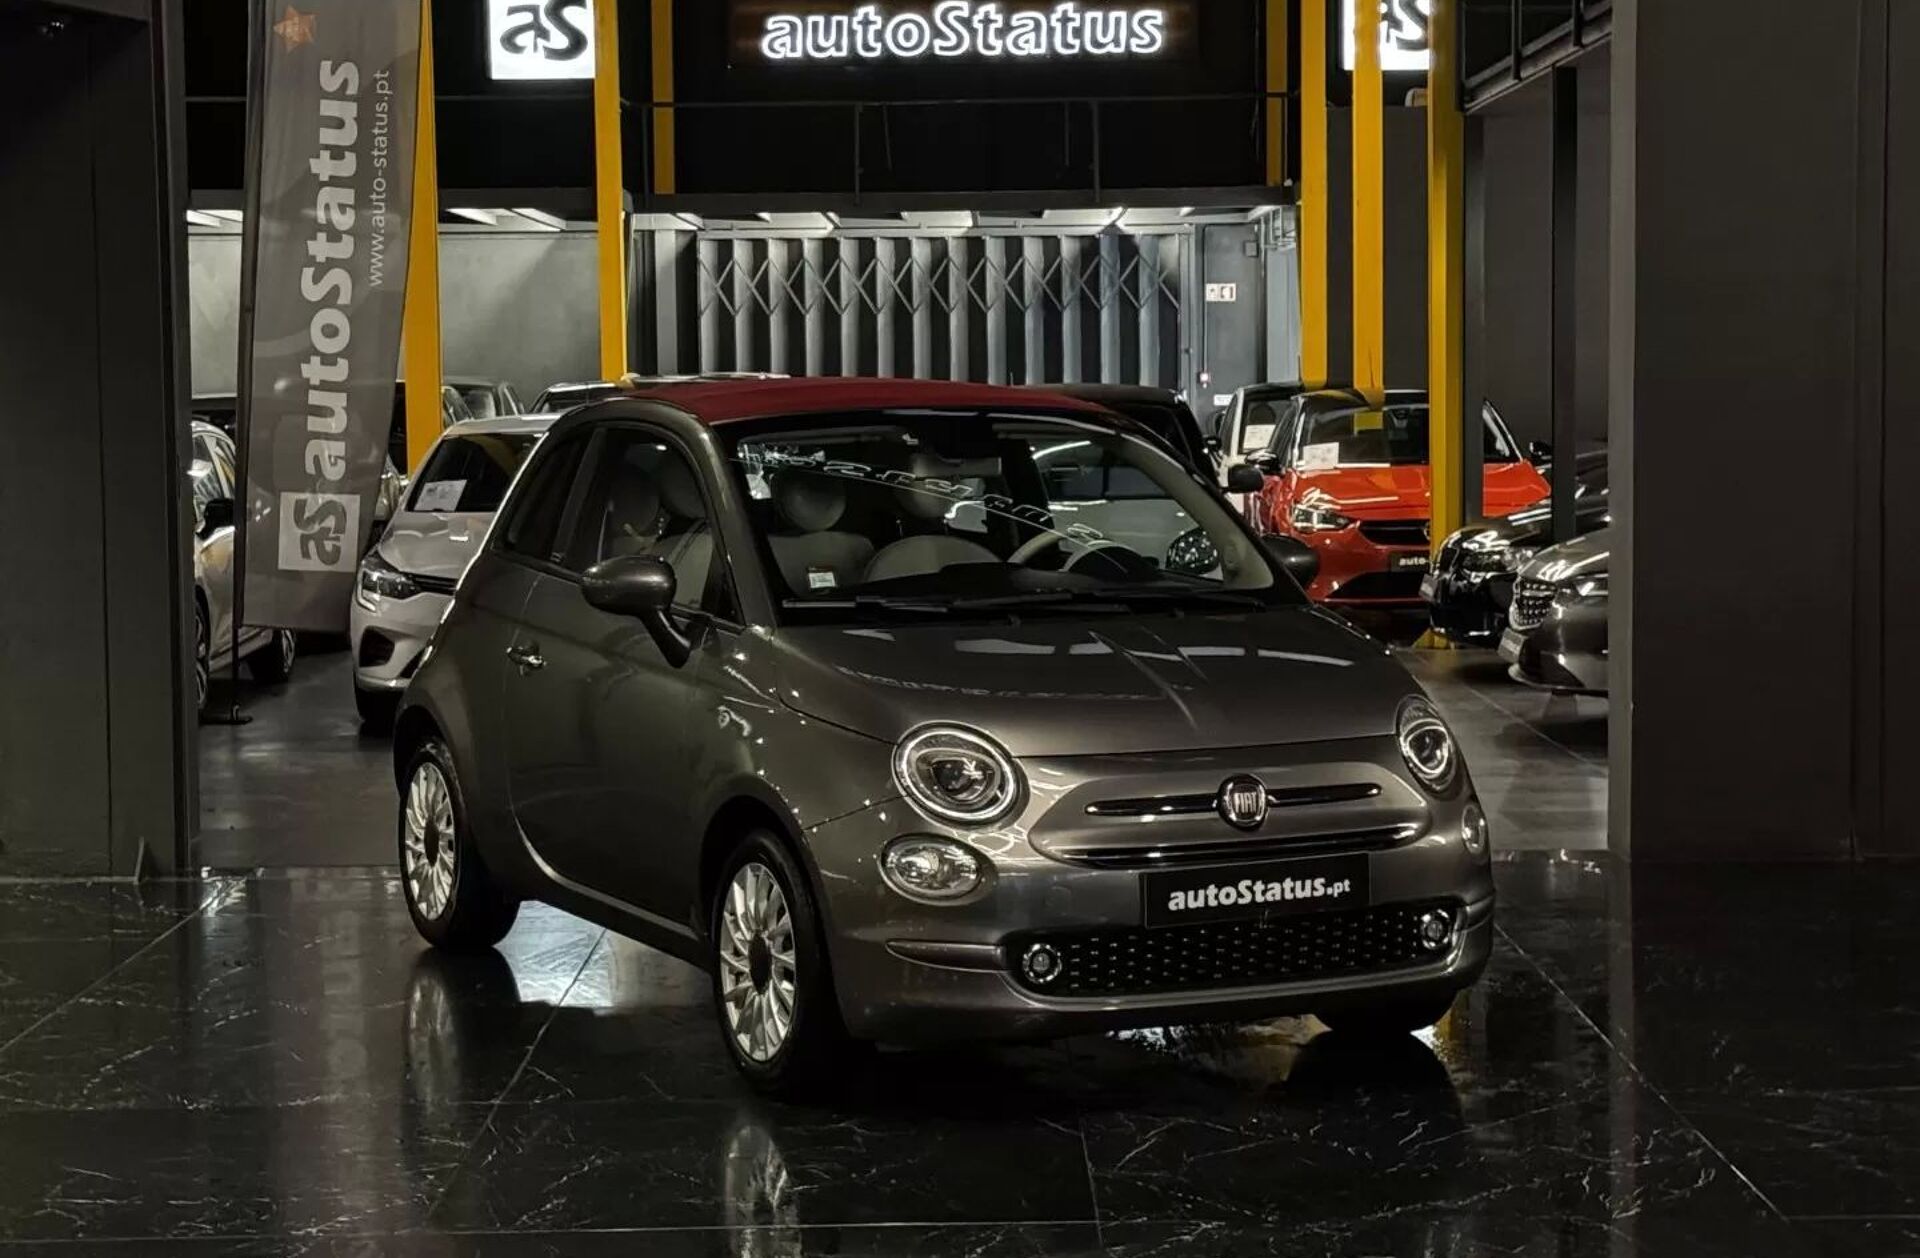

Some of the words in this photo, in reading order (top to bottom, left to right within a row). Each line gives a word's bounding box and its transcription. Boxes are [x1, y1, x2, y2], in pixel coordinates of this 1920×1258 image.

[761, 0, 1165, 59] autoStatus
[369, 69, 394, 287] www.auto-status.pt
[301, 60, 360, 481] autoStatus
[1234, 791, 1257, 813] FIAT
[1168, 877, 1350, 911] autoStatus.pt
